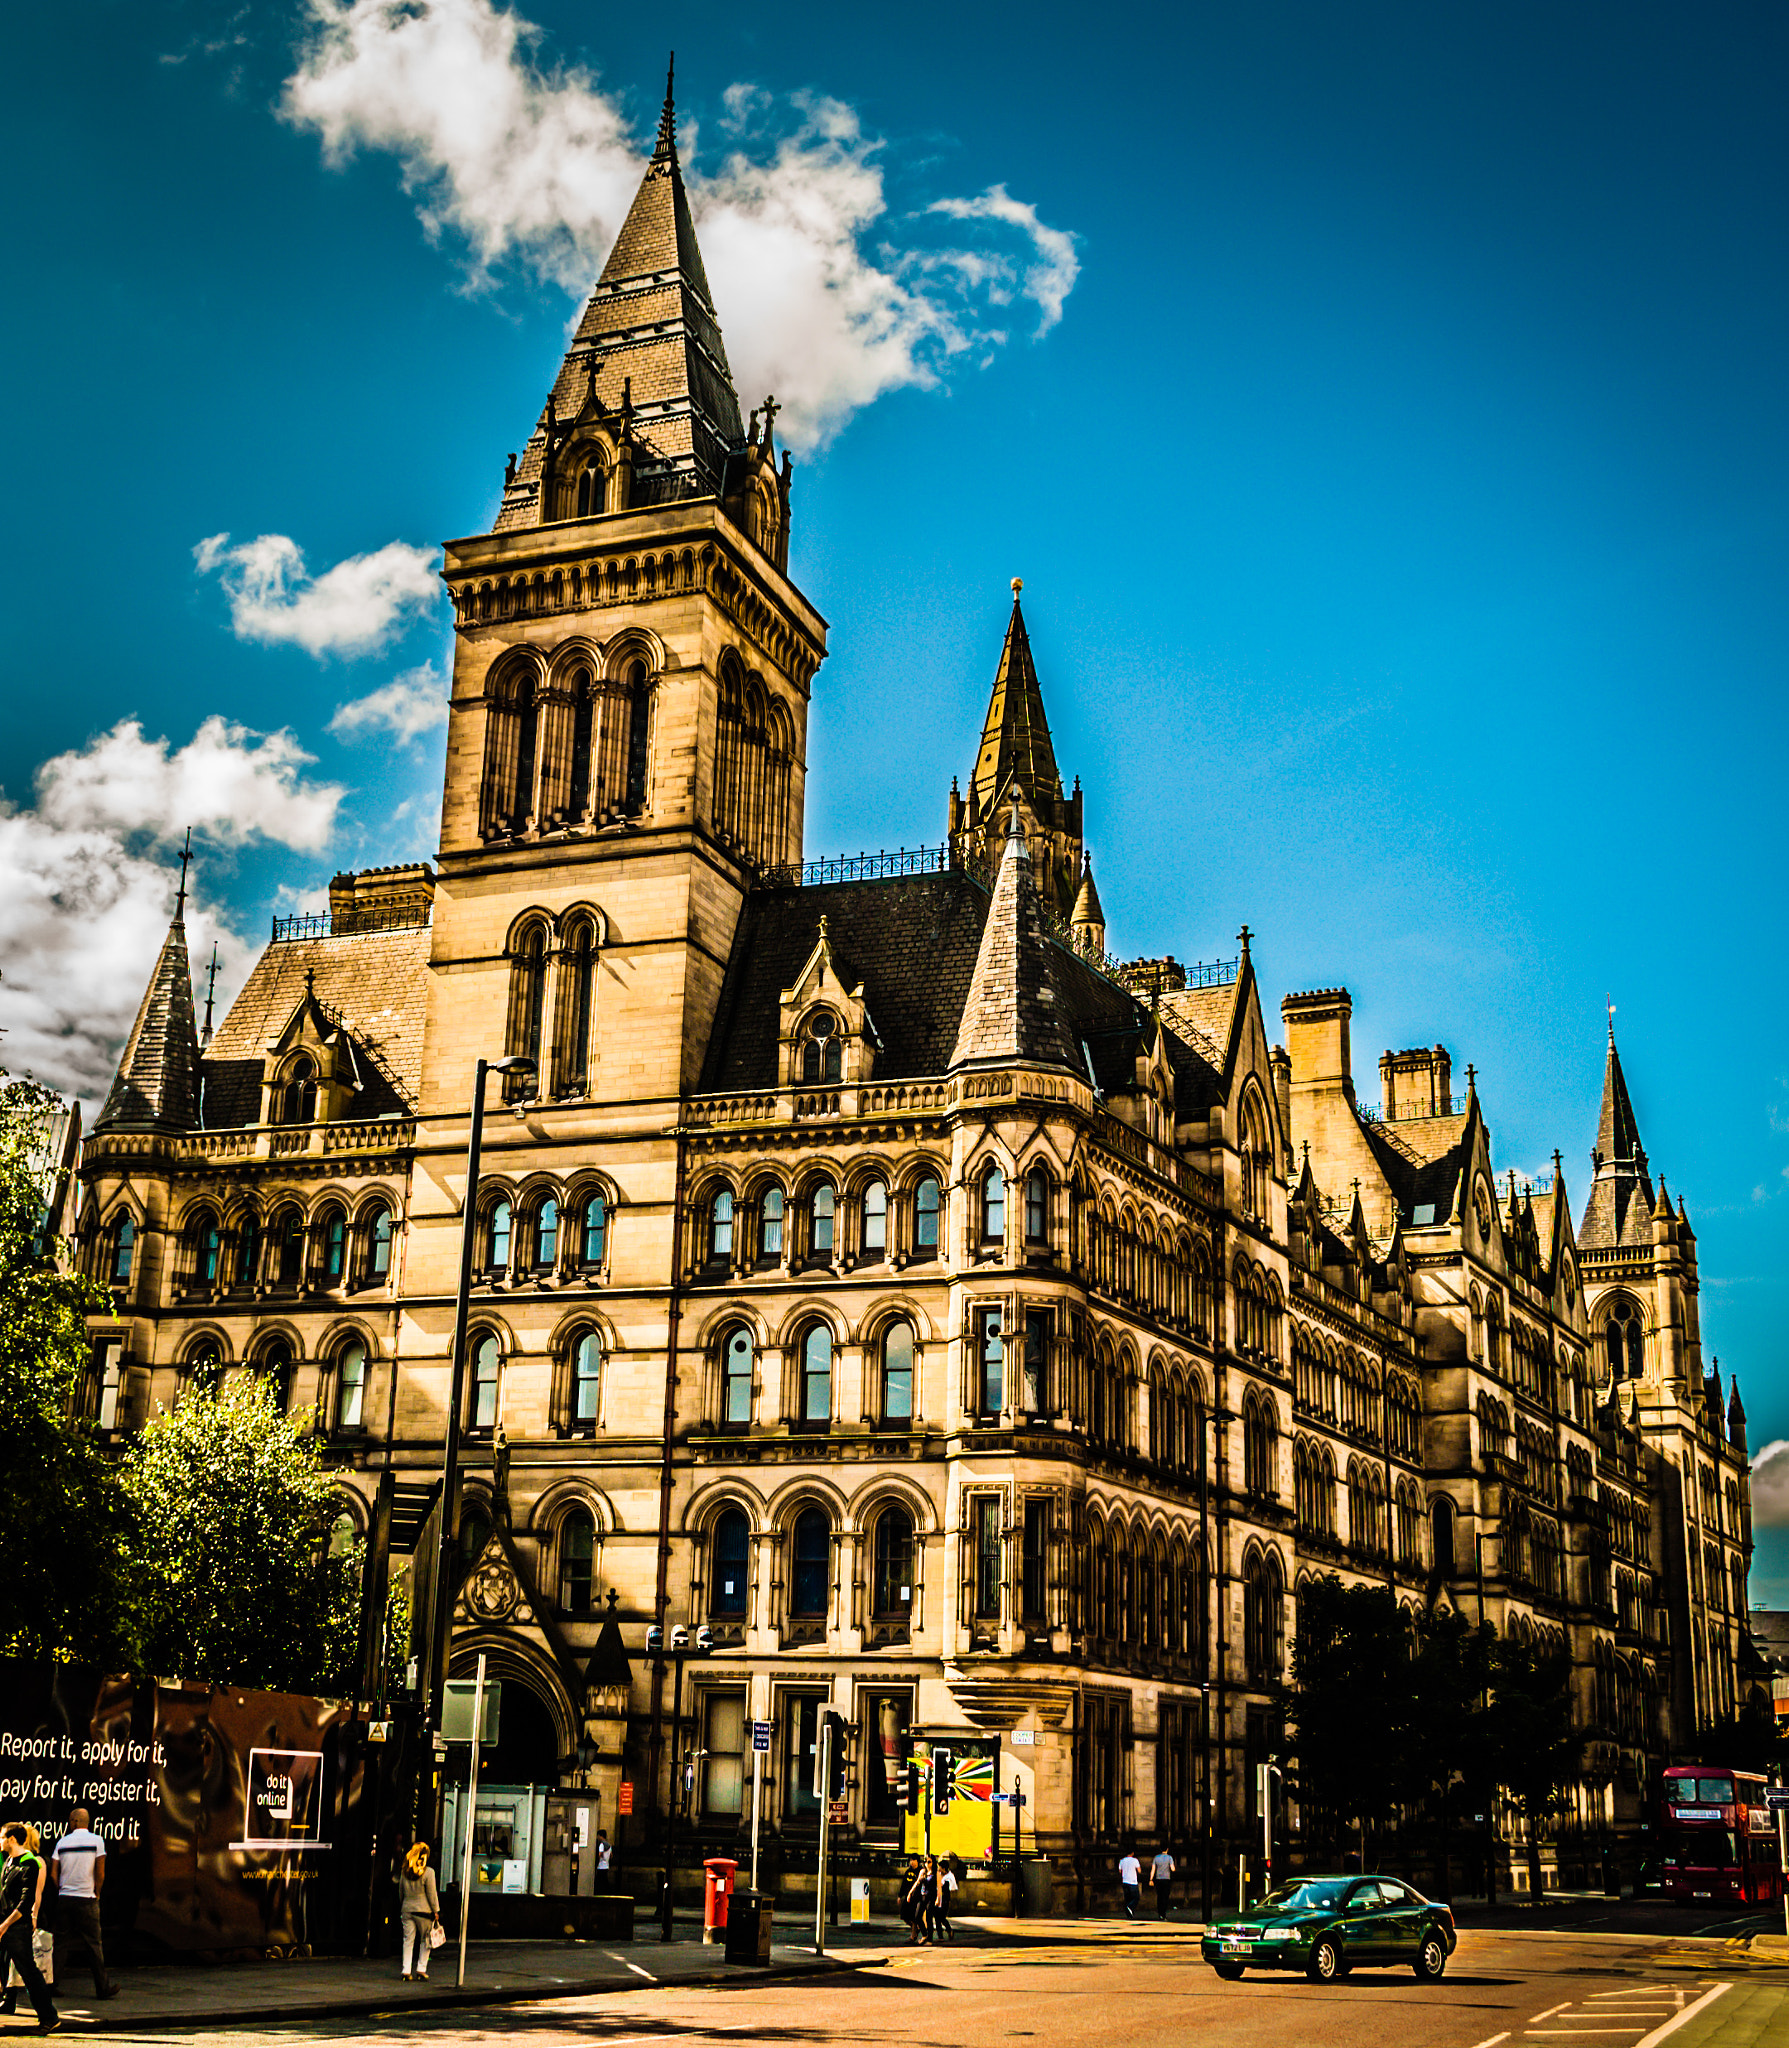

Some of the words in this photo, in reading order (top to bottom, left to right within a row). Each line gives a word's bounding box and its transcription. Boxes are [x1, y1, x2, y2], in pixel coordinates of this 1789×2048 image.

[1, 1732, 57, 1761] Report
[60, 1734, 77, 1763] it,
[81, 1738, 125, 1766] apply
[127, 1740, 150, 1763] for
[152, 1741, 168, 1768] it,
[0, 1778, 31, 1803] pay
[33, 1774, 59, 1798] for
[61, 1775, 77, 1804] it,
[82, 1777, 143, 1805] register
[145, 1779, 161, 1806] it,
[266, 1773, 279, 1789] do
[279, 1773, 287, 1789] it
[257, 1791, 286, 1806] online
[18, 1820, 69, 1840] new
[93, 1816, 125, 1840] find
[128, 1816, 141, 1840] it
[242, 1870, 318, 1880] www.mancheter.gov.uk
